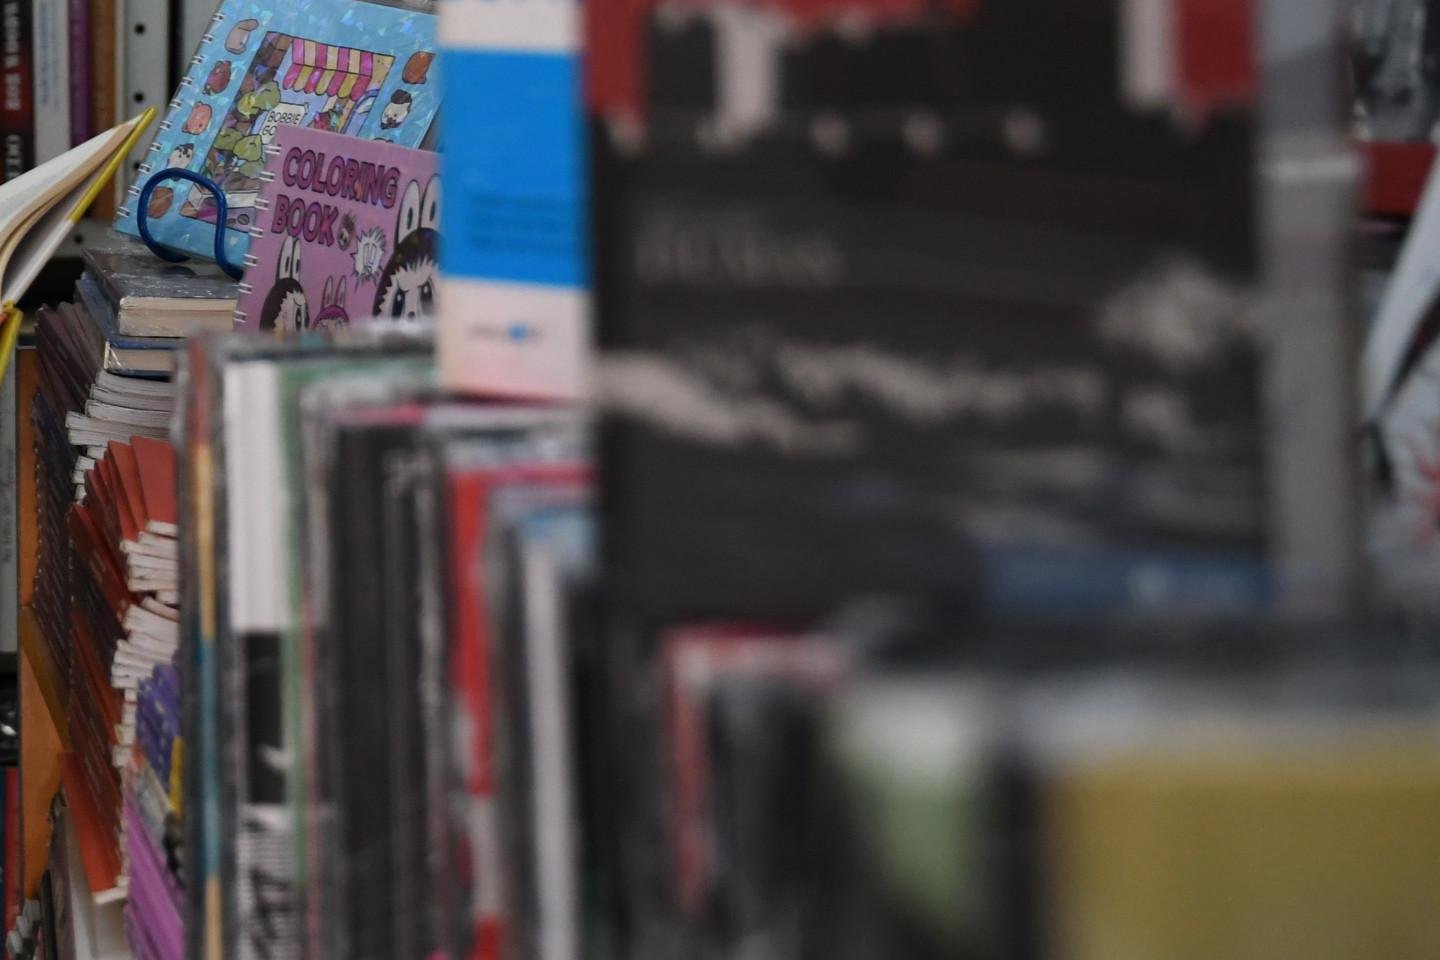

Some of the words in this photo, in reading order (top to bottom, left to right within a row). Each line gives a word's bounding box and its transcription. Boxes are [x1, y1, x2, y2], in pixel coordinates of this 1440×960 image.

[267, 111, 301, 125] BOBBIE
[281, 146, 401, 209] COLORING
[271, 193, 340, 248] BOOK
